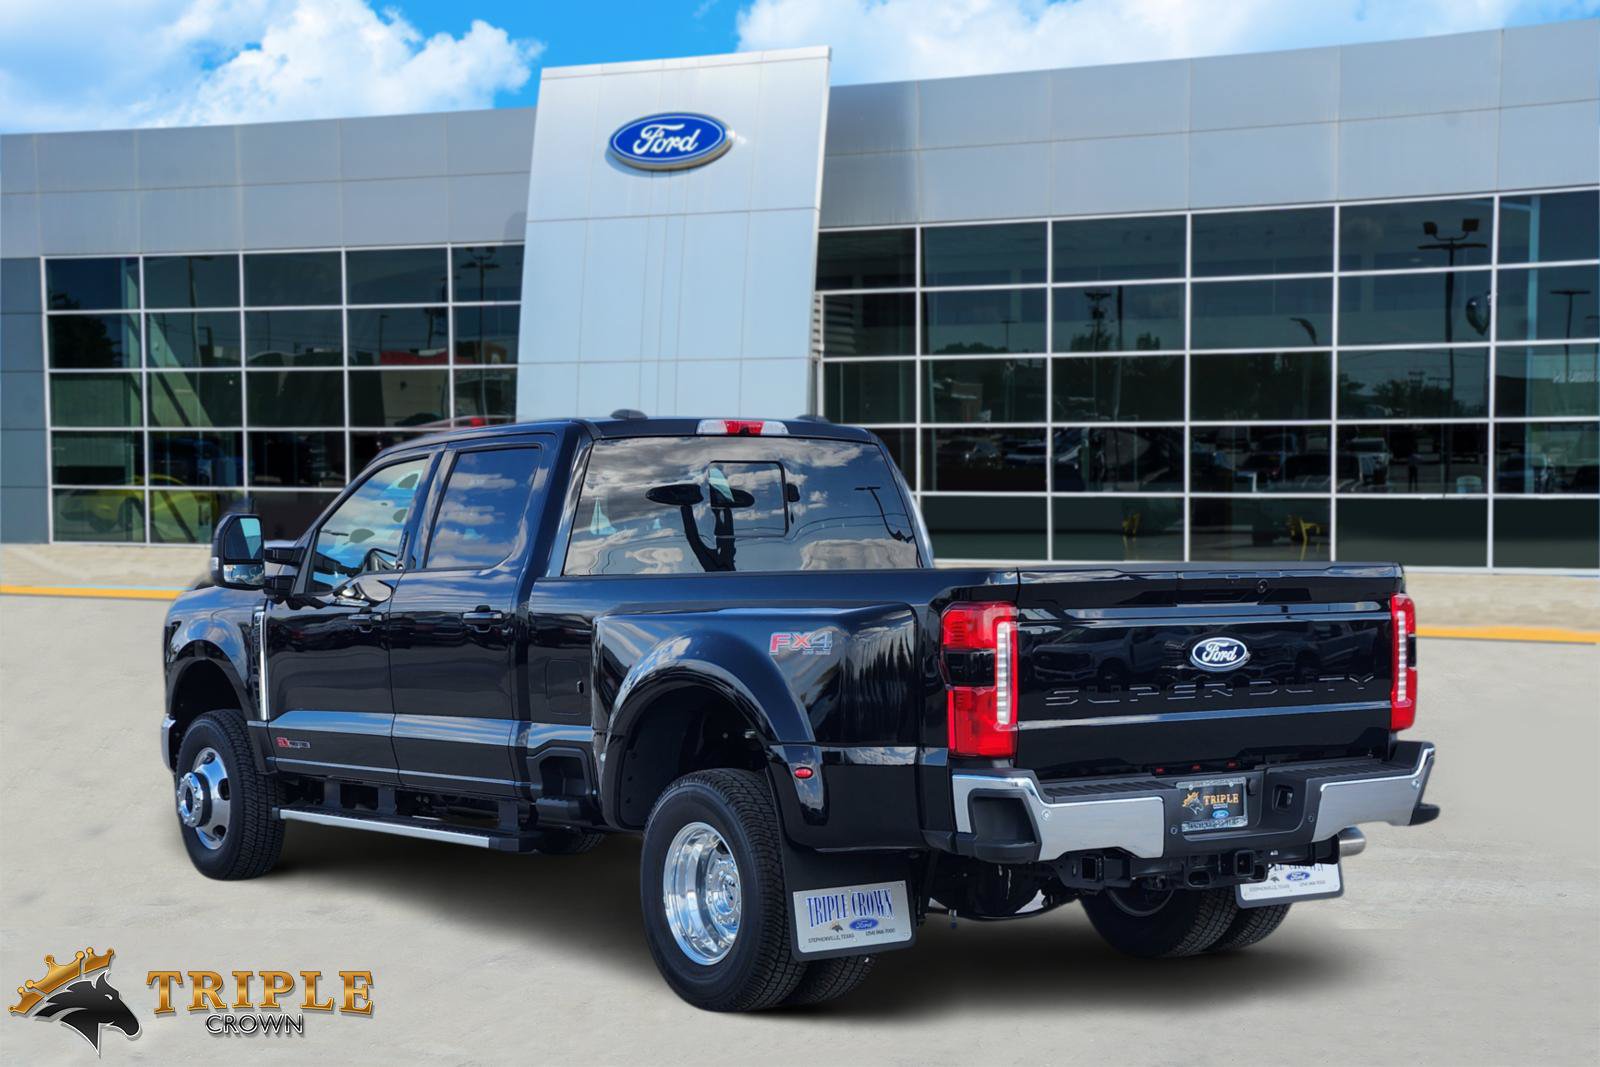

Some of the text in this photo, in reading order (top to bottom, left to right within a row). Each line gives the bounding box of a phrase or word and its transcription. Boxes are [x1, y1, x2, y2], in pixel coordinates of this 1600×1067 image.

[632, 123, 702, 155] Ford
[768, 631, 832, 655] FX4
[1201, 640, 1238, 663] Ford
[1203, 793, 1239, 806] TRIPLE
[806, 889, 894, 928] TRIPLE CROWN
[856, 920, 873, 930] Ford
